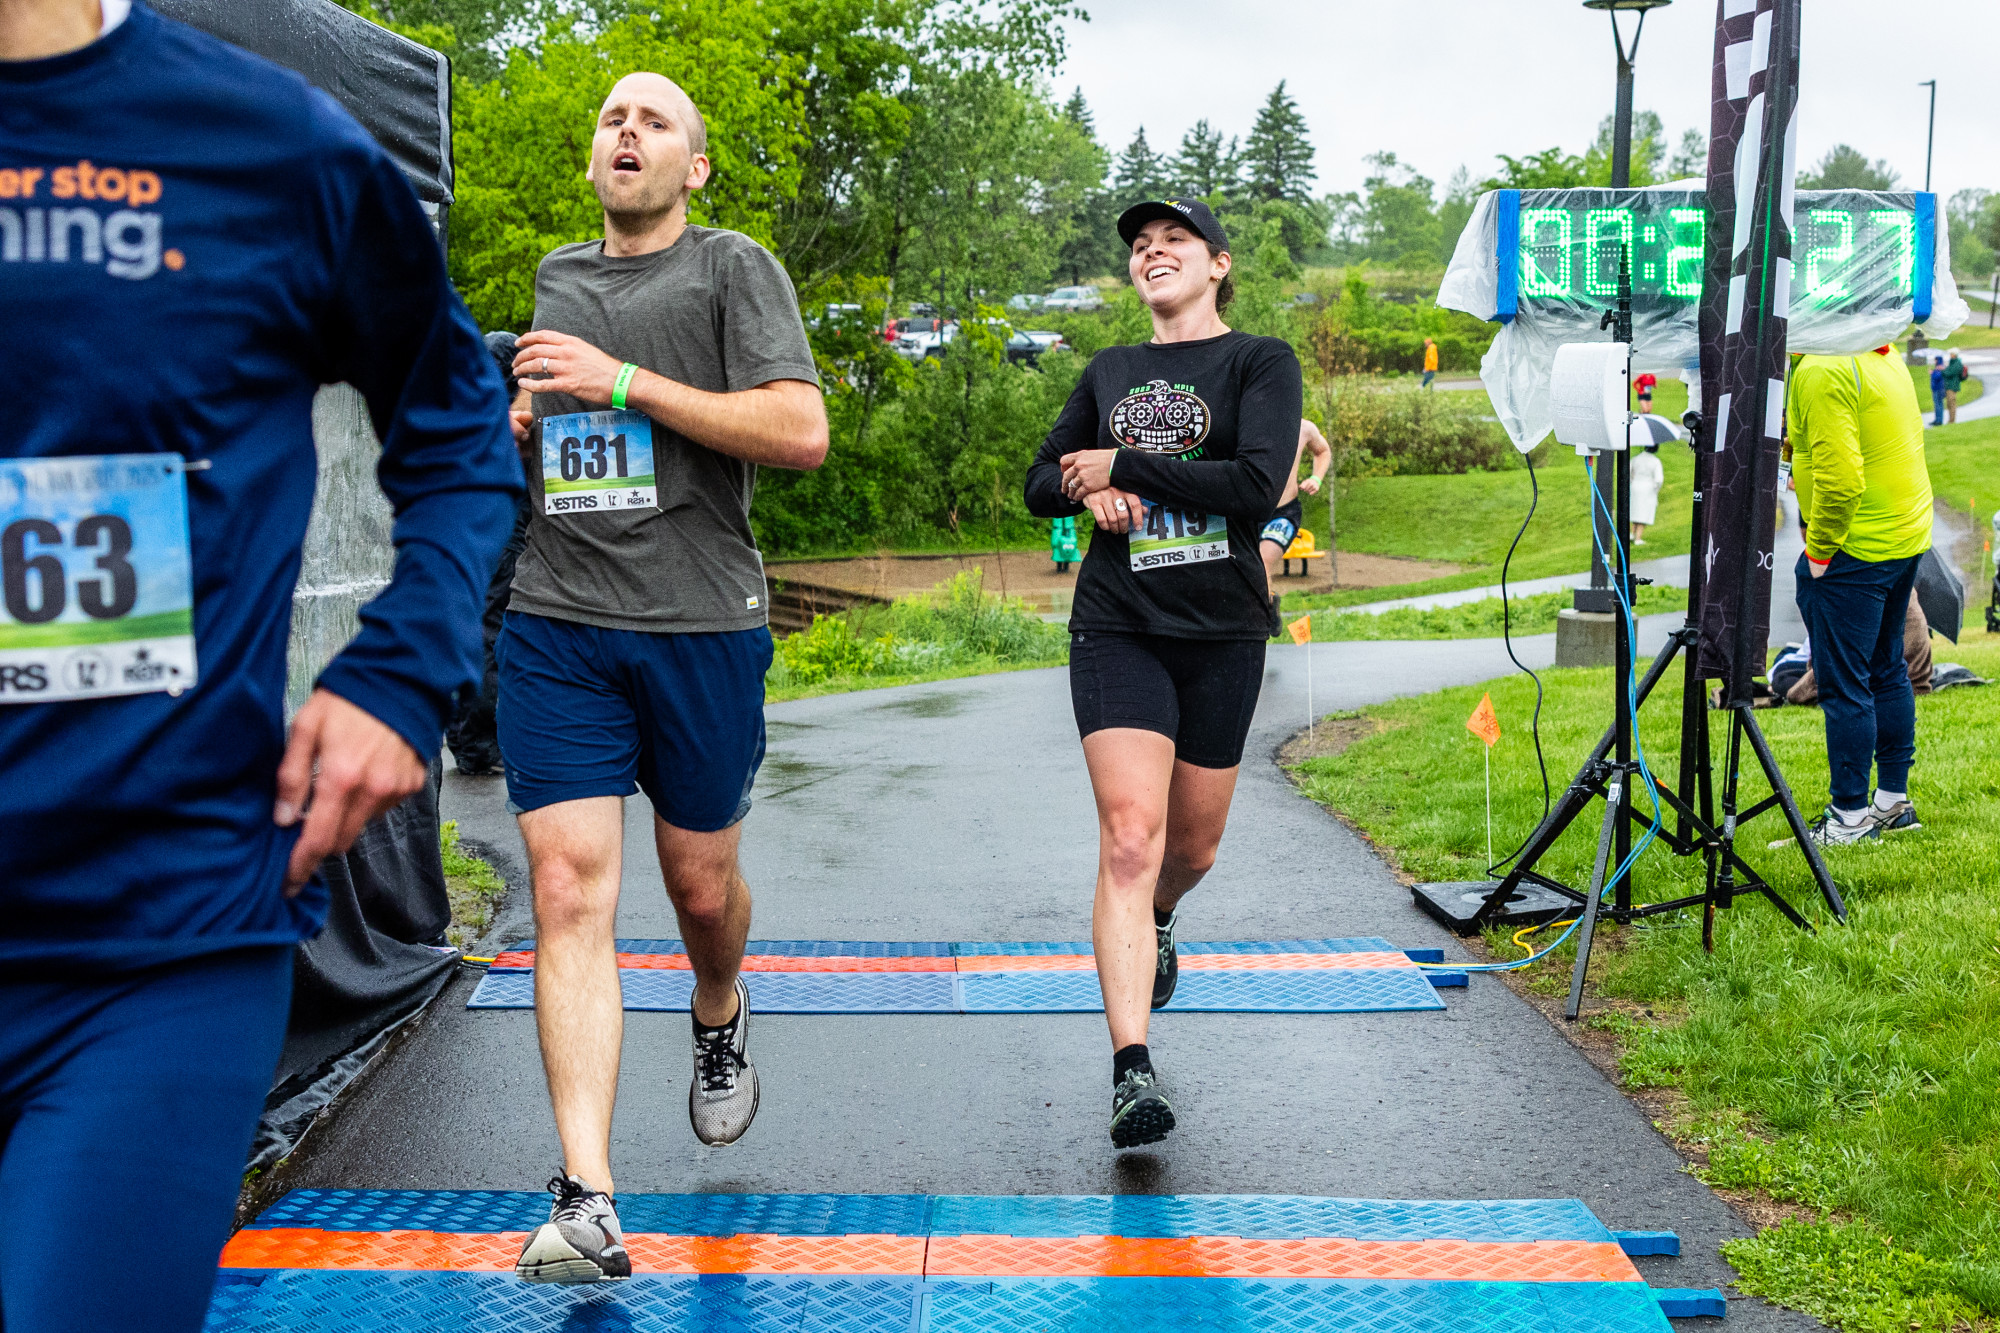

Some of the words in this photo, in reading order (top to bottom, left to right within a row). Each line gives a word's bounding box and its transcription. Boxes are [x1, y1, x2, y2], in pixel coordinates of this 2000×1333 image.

[52, 159, 163, 207] stop
[560, 433, 628, 482] 631
[1147, 504, 1207, 540] 419
[2, 514, 137, 625] 63
